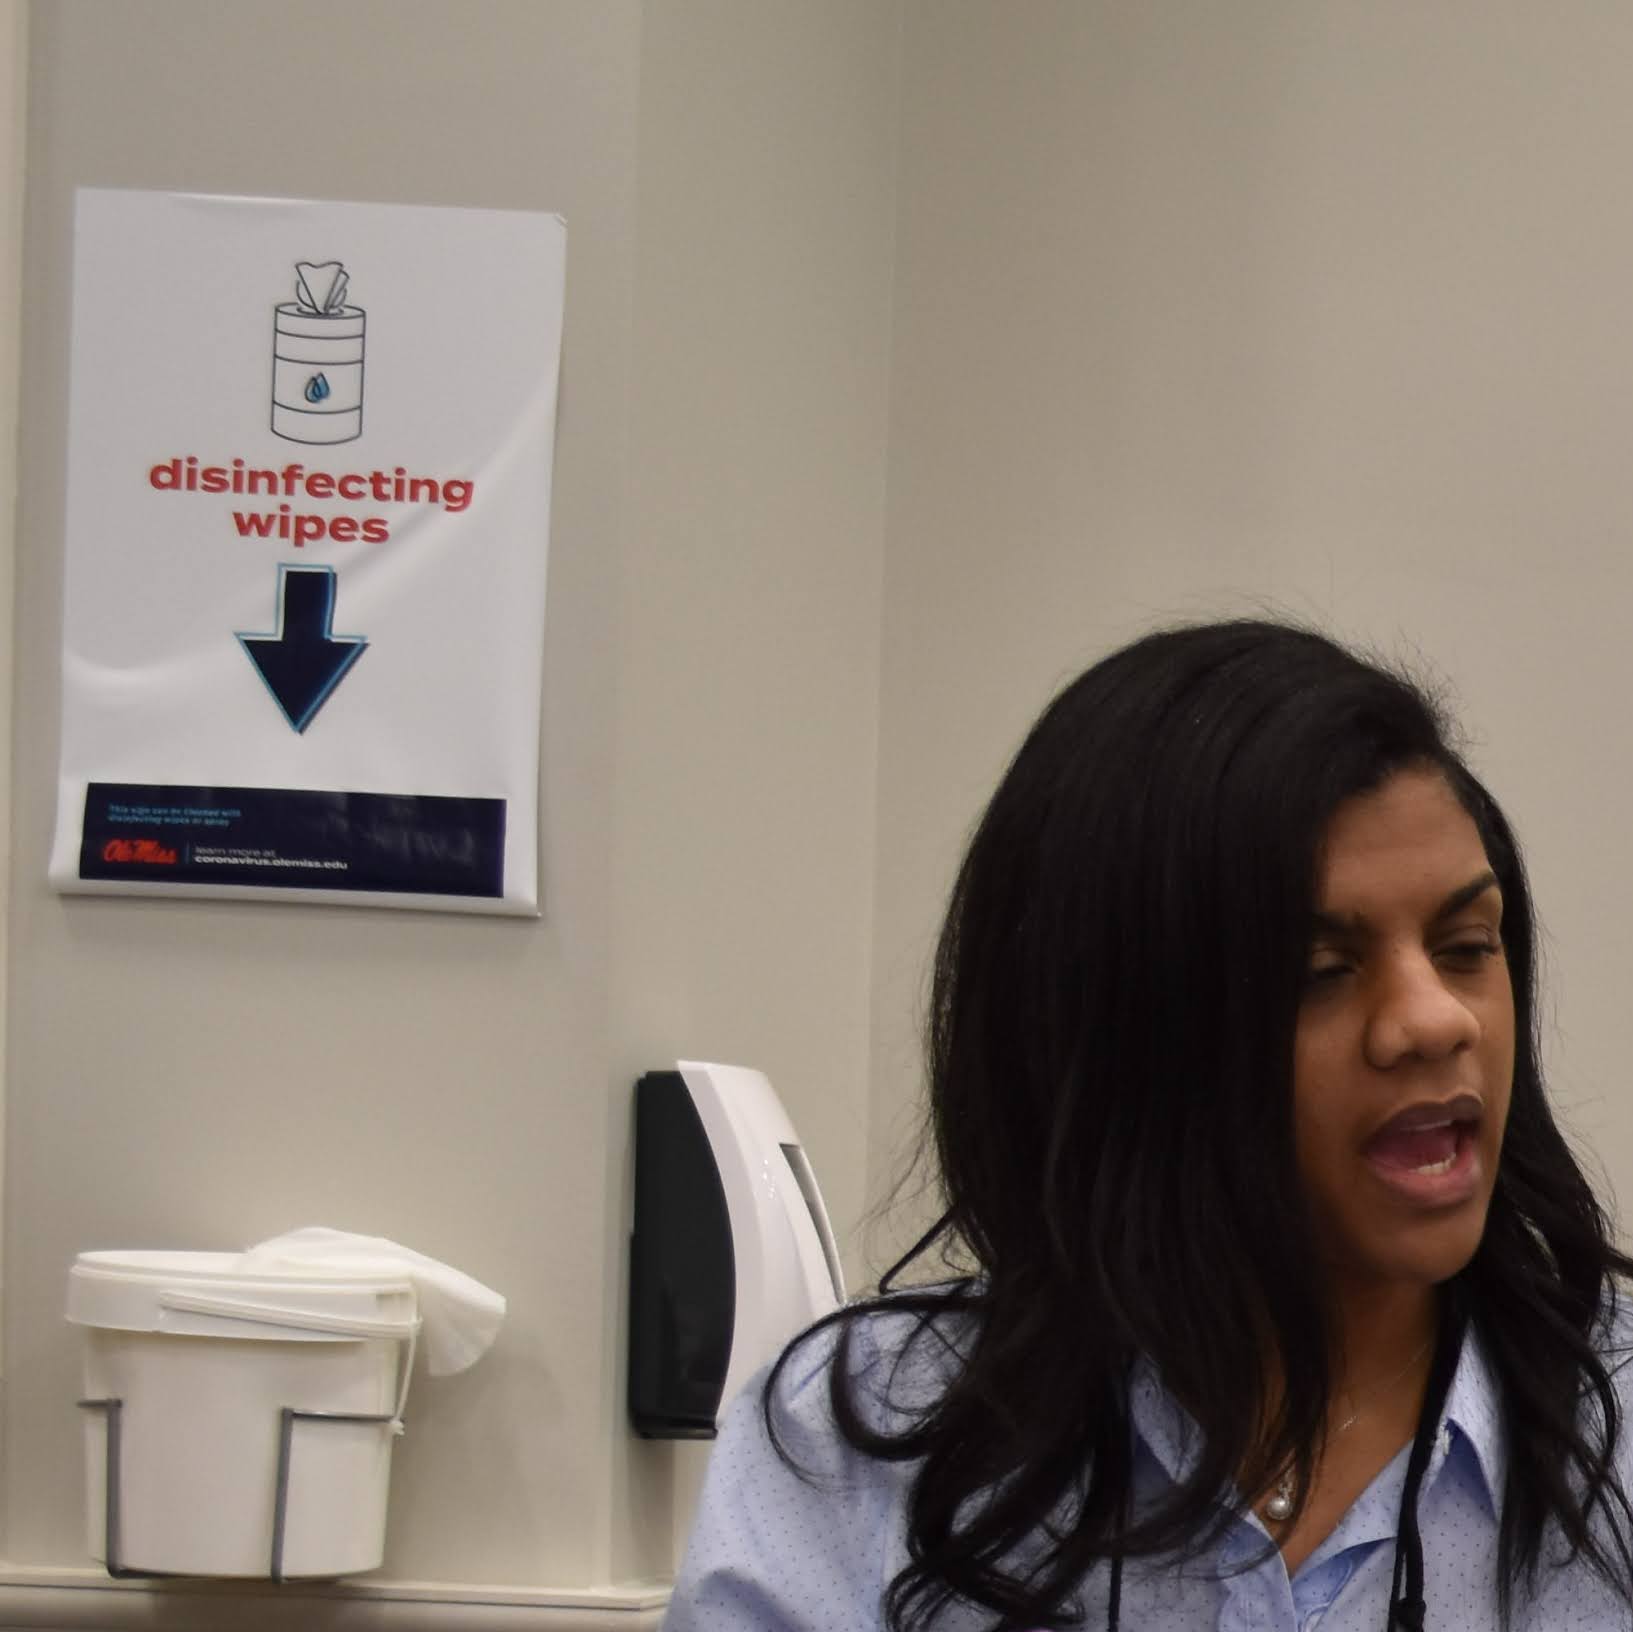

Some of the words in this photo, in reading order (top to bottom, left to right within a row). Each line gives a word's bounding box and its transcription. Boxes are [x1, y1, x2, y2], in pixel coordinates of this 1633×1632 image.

[149, 456, 474, 512] disinfecting
[232, 504, 390, 548] wipes
[103, 839, 131, 863] Ole
[132, 839, 177, 864] Miss
[194, 854, 348, 870] coronavirus.olemiss.edu
[195, 846, 226, 856] learn
[229, 848, 259, 858] more
